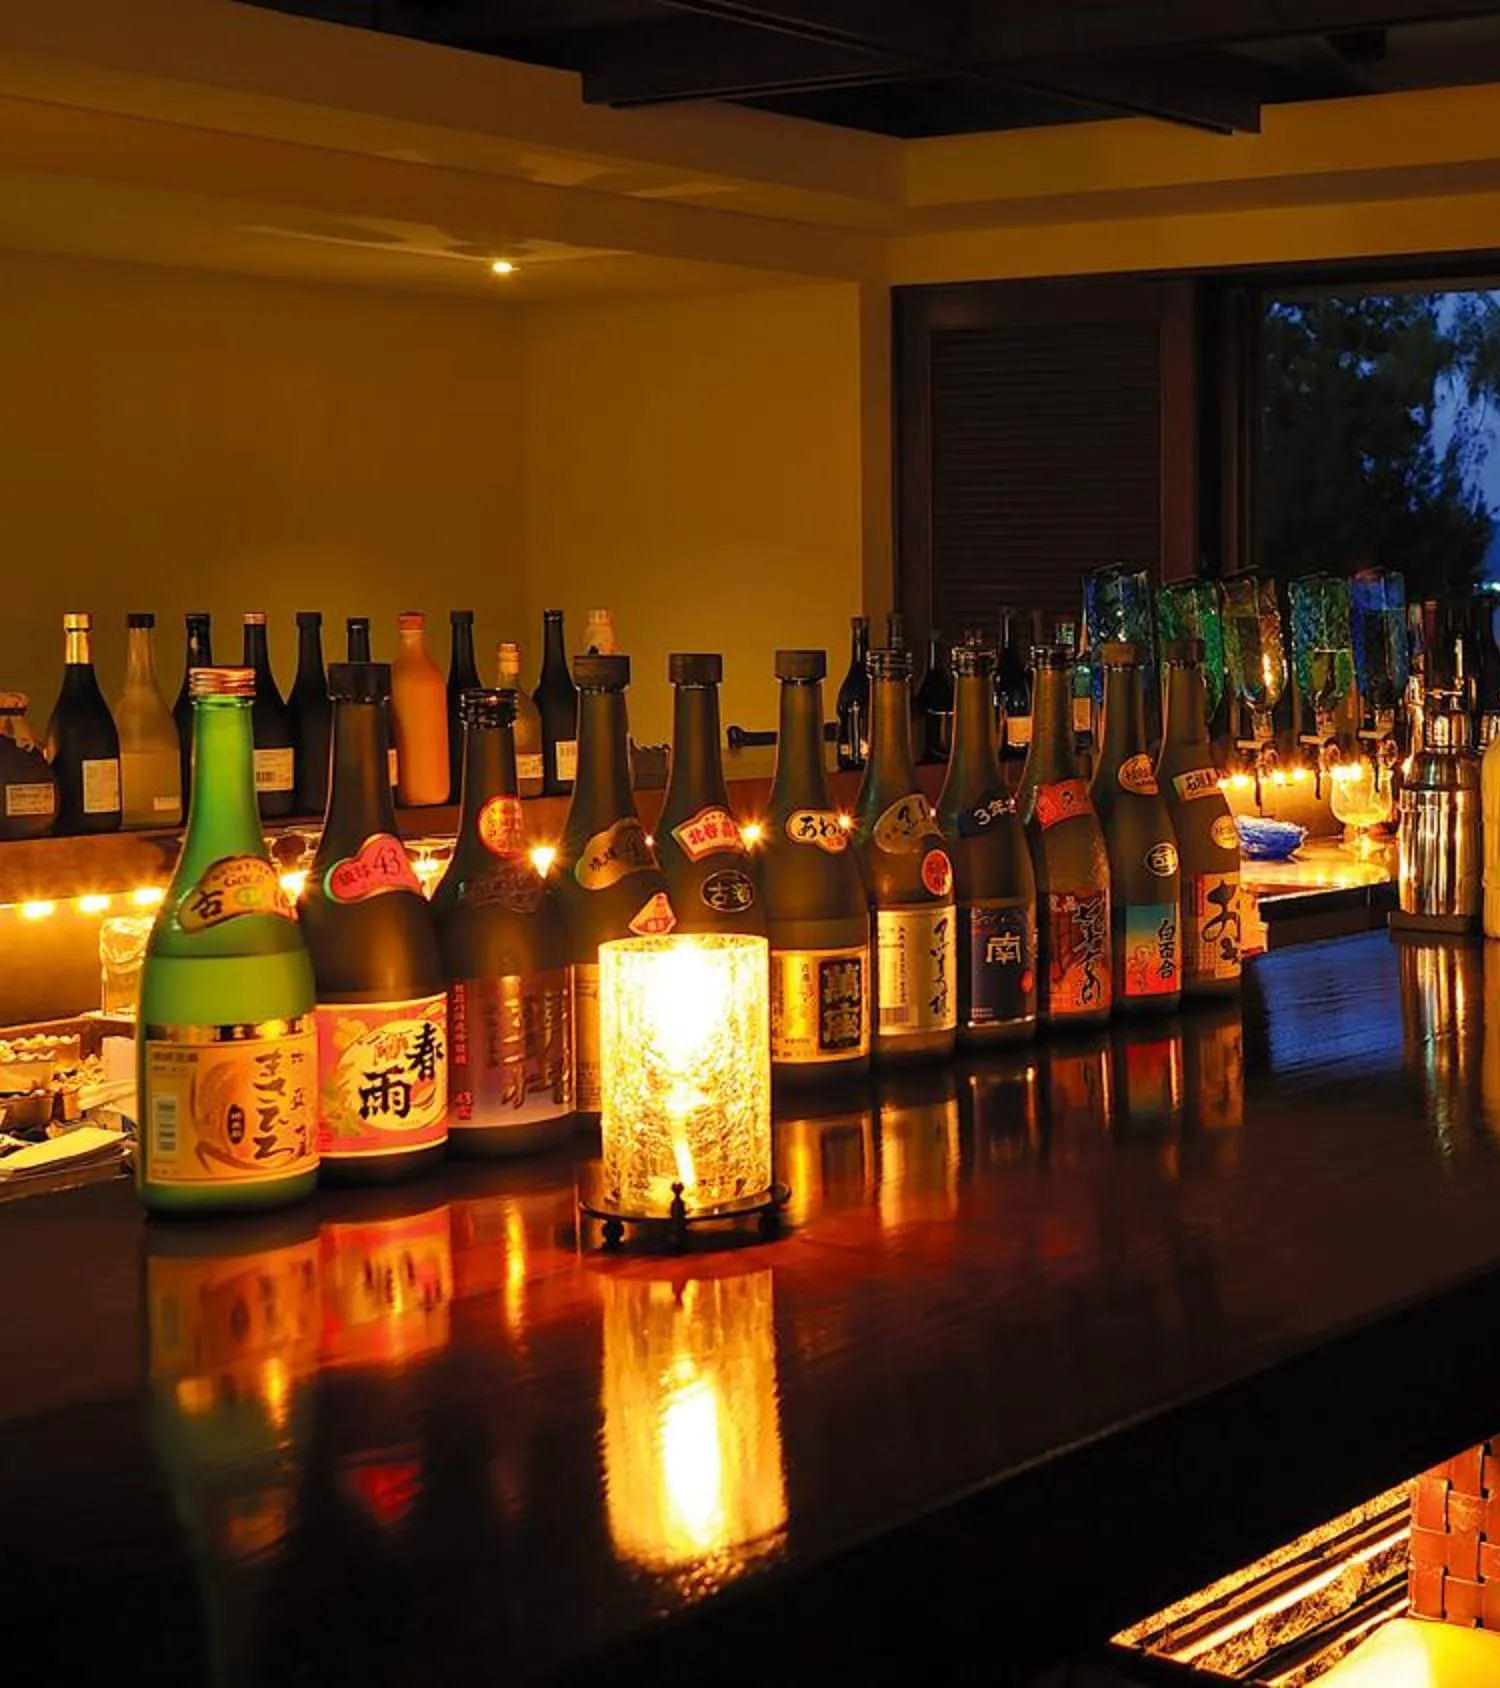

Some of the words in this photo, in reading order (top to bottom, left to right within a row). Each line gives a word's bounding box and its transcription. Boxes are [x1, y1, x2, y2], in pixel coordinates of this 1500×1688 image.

[985, 930, 1021, 965] 南
[1157, 917, 1176, 980] 白百合
[358, 1022, 446, 1121] 春雨
